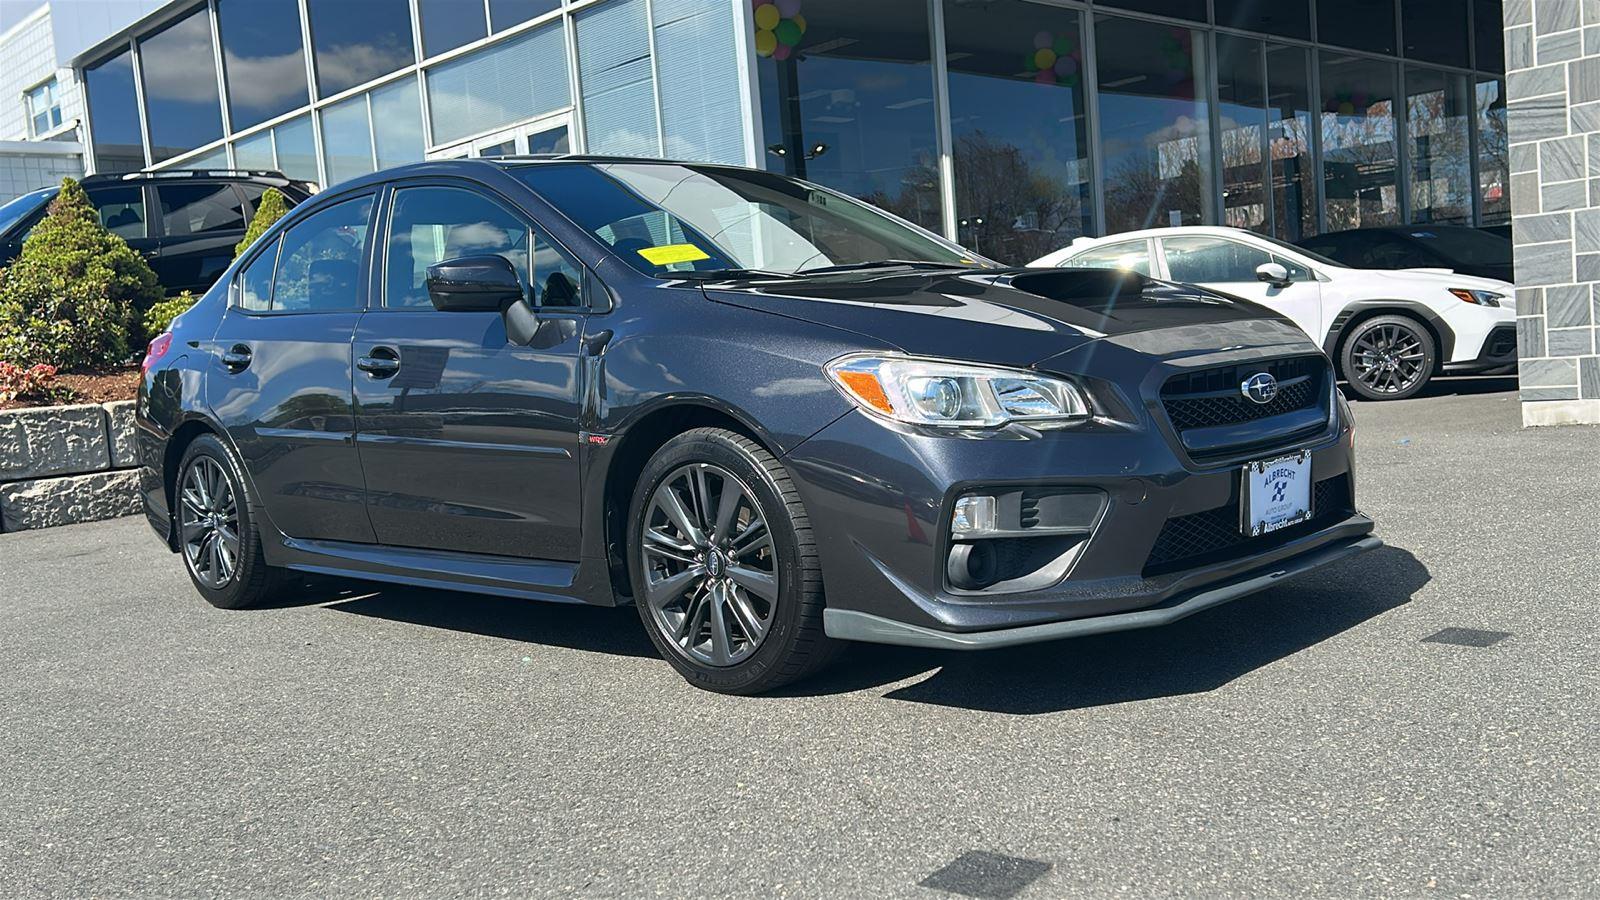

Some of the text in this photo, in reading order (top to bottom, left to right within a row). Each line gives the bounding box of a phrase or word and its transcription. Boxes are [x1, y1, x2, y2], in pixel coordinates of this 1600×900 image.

[589, 436, 605, 444] WRX
[1264, 468, 1296, 488] ALBRECHT
[1265, 505, 1277, 515] AUTO
[1264, 517, 1288, 534] Albrecht
